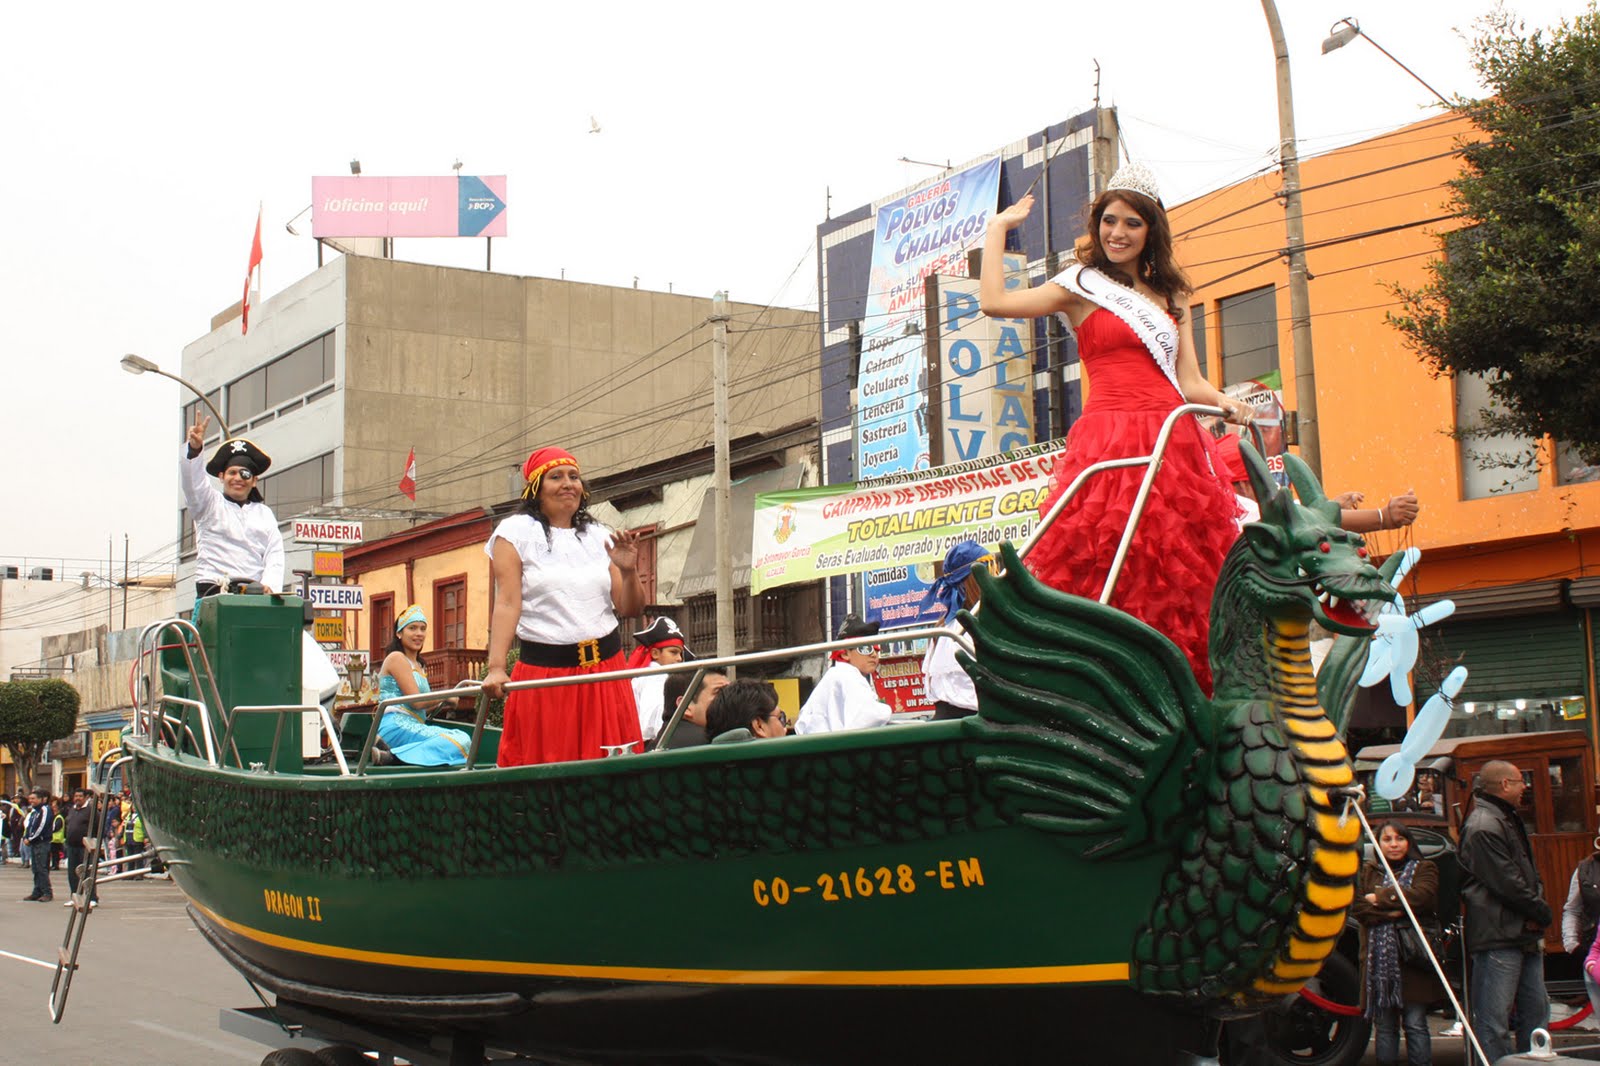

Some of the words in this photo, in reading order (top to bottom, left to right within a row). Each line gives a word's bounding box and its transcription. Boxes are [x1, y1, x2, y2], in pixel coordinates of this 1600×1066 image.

[885, 191, 960, 242] POLVOS
[893, 209, 989, 267] CHALACOS
[890, 284, 904, 297] EN
[905, 274, 919, 290] SU
[1105, 292, 1134, 311] Miss
[1132, 308, 1158, 332] Teen
[868, 335, 895, 353] Ropa
[865, 353, 905, 375] Calzado
[863, 373, 910, 398] Celulares
[862, 419, 907, 444] Sastrería
[856, 468, 939, 489] MUNICIPALIDAD
[941, 454, 1012, 476] PROVINCIAL
[1012, 447, 1038, 461] DEL
[862, 445, 899, 468] Joyería
[823, 491, 892, 519] CAMPAÑA
[894, 487, 915, 506] DE
[914, 466, 1012, 502] DESPISTAJE
[1009, 461, 1038, 483] DE
[295, 523, 362, 540] PANADERIA
[848, 496, 996, 543] TOTALMENTE
[844, 544, 890, 566] Evaluado,
[892, 536, 933, 561] operado
[934, 537, 943, 556] y
[944, 525, 1001, 550] controlado
[1004, 525, 1018, 541] en
[1020, 519, 1031, 538] el
[867, 566, 908, 586] Comidas
[296, 589, 363, 605] PSTELERIA
[316, 622, 342, 638] TORTAS
[884, 680, 897, 689] LES
[898, 678, 910, 688] DA
[910, 677, 921, 686] LA
[906, 699, 917, 708] UN
[264, 888, 305, 920] DRAGON
[307, 896, 323, 922] II
